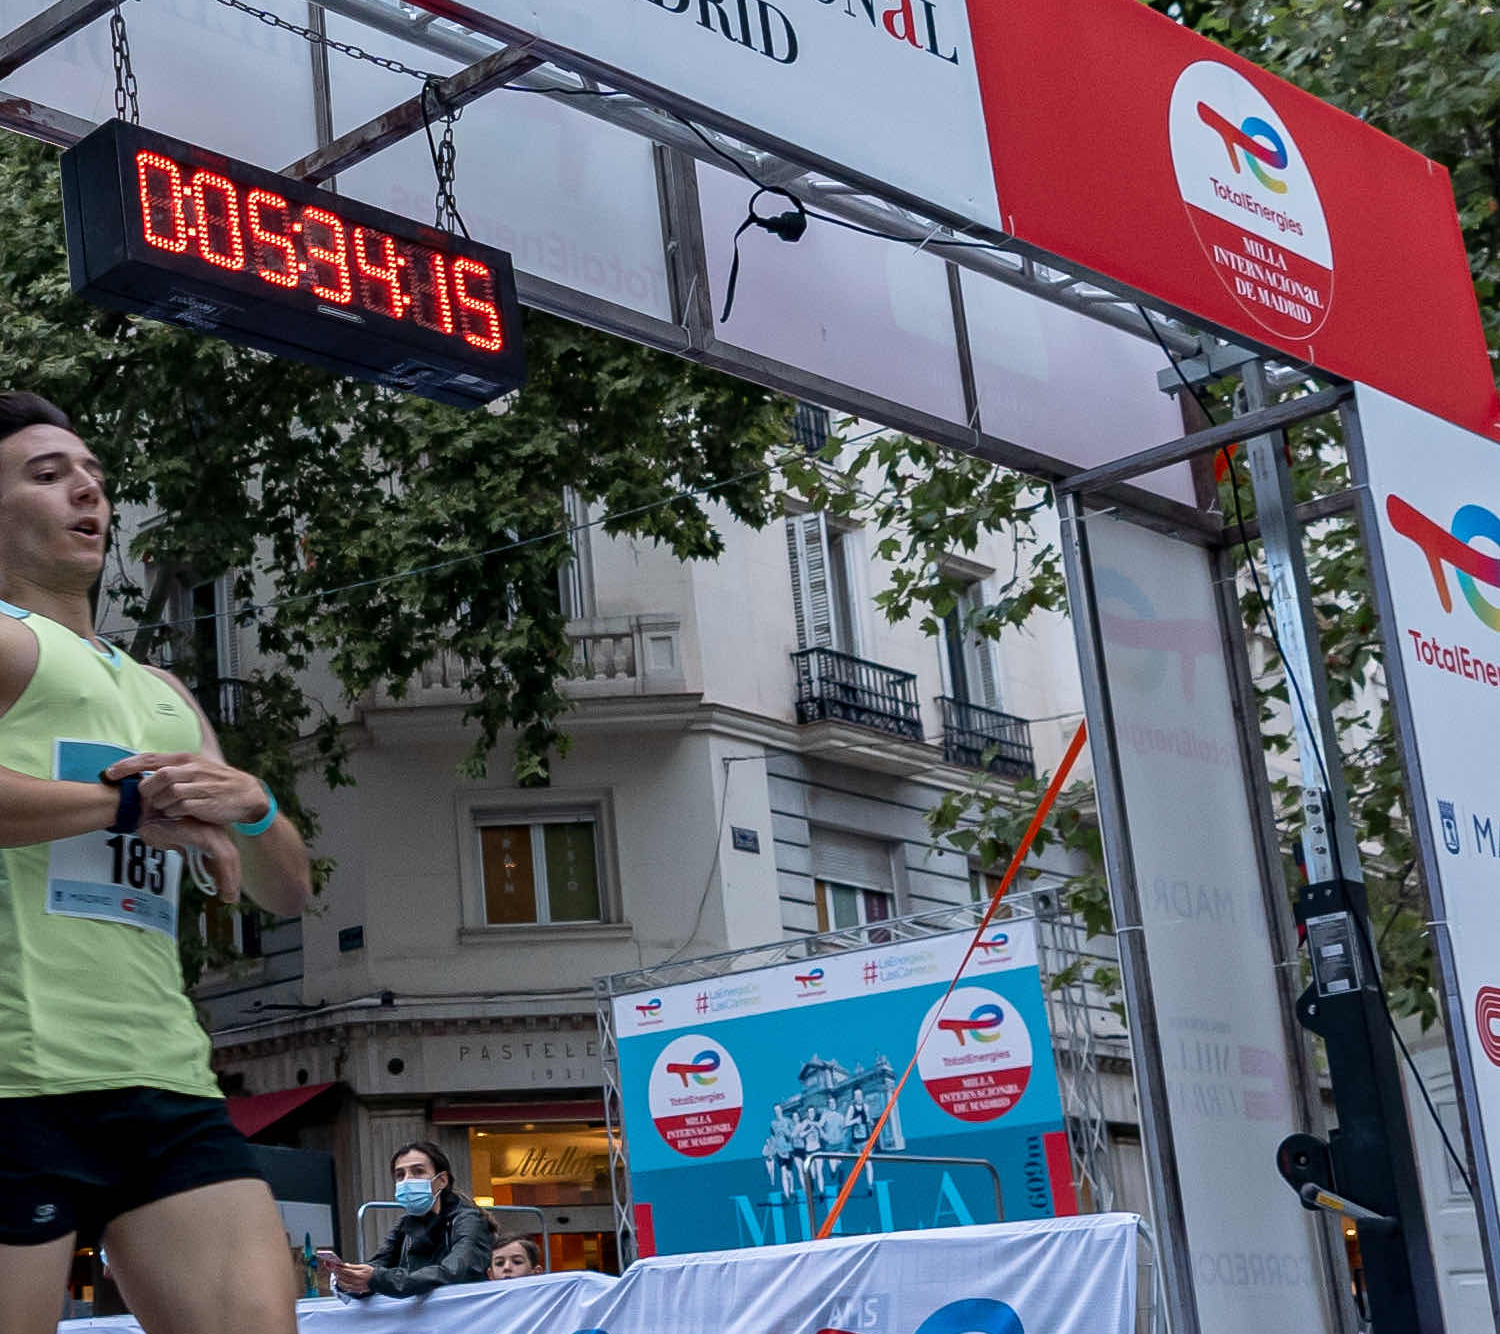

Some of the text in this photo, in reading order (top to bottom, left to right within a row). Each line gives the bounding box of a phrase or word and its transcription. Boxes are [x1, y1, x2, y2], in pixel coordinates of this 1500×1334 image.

[1209, 176, 1304, 237] TotalEnergies
[1242, 235, 1288, 271] MILLA
[1235, 277, 1312, 325] DE MADRID
[105, 834, 166, 896] 183
[827, 1297, 880, 1328] AMS
